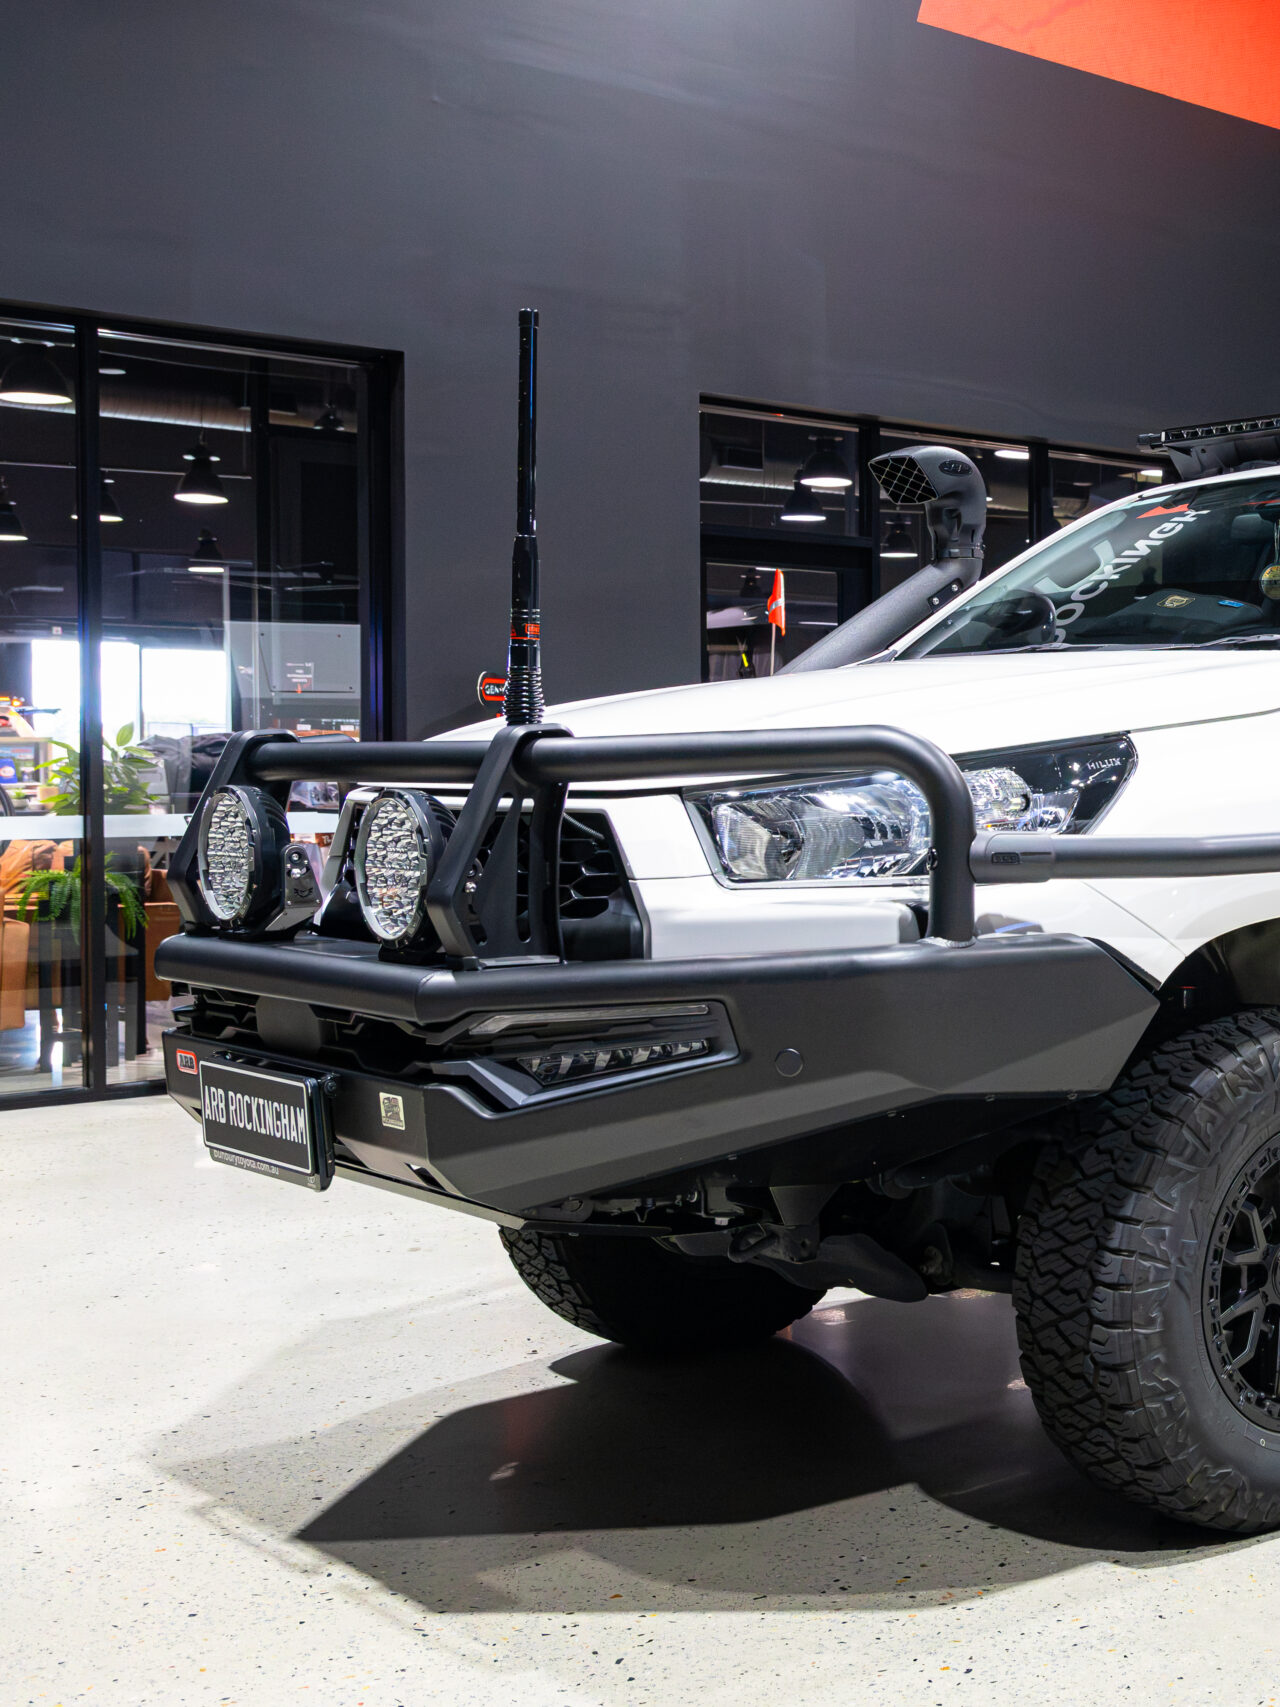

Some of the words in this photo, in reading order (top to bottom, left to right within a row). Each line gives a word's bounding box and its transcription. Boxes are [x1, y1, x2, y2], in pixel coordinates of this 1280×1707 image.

[1086, 757, 1122, 770] HILUX
[178, 1054, 195, 1070] ARB
[204, 1085, 226, 1124] ARB
[228, 1090, 307, 1145] ROCKINGHAM
